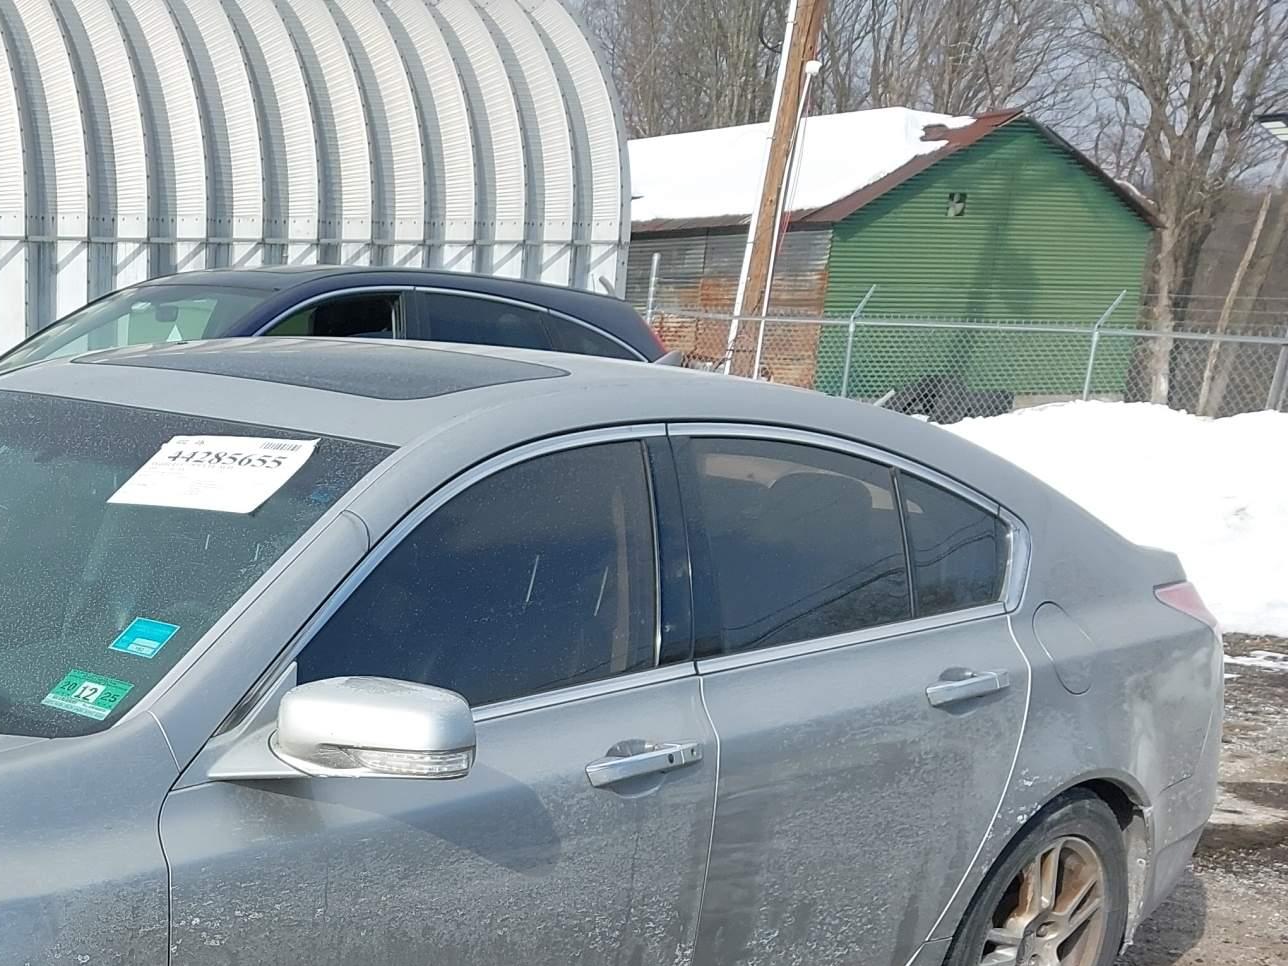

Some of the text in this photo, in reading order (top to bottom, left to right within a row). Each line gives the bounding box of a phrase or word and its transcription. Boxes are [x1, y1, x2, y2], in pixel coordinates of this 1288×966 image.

[167, 449, 288, 470] 44285655
[60, 680, 79, 692] 20
[73, 685, 99, 702] 12
[99, 691, 120, 704] 25
